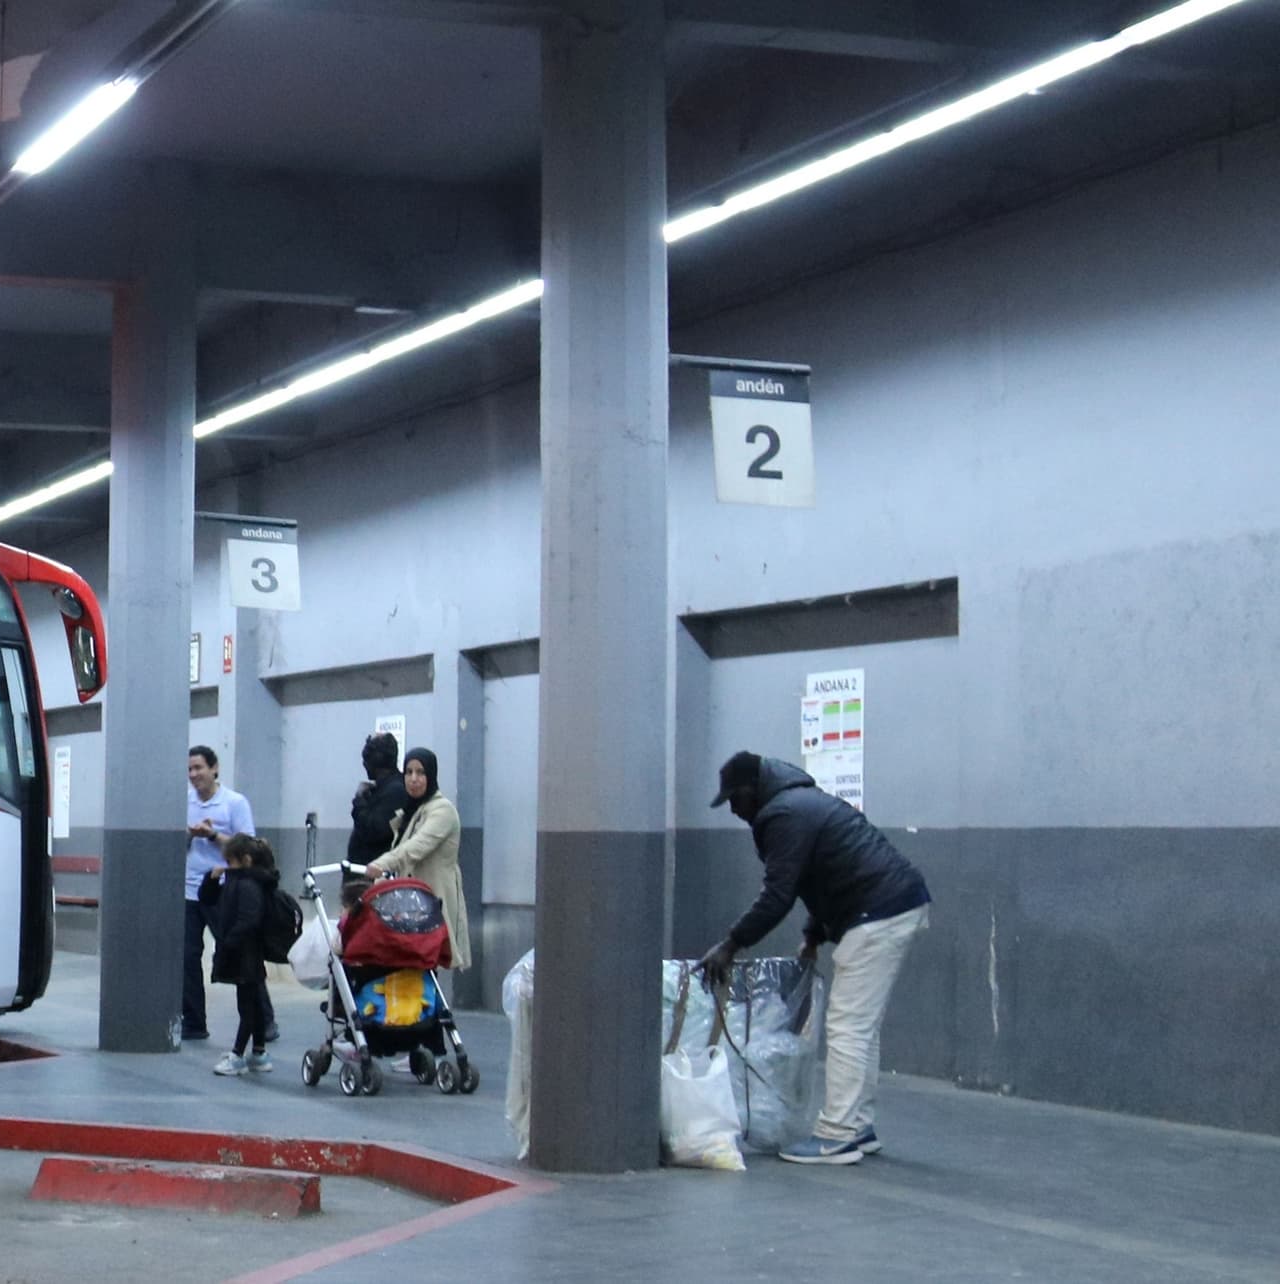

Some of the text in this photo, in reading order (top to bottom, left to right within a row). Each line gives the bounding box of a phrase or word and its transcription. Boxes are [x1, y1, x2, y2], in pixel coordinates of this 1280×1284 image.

[735, 377, 785, 395] andén
[745, 424, 783, 480] 2
[241, 527, 283, 540] andana
[251, 557, 279, 593] 3
